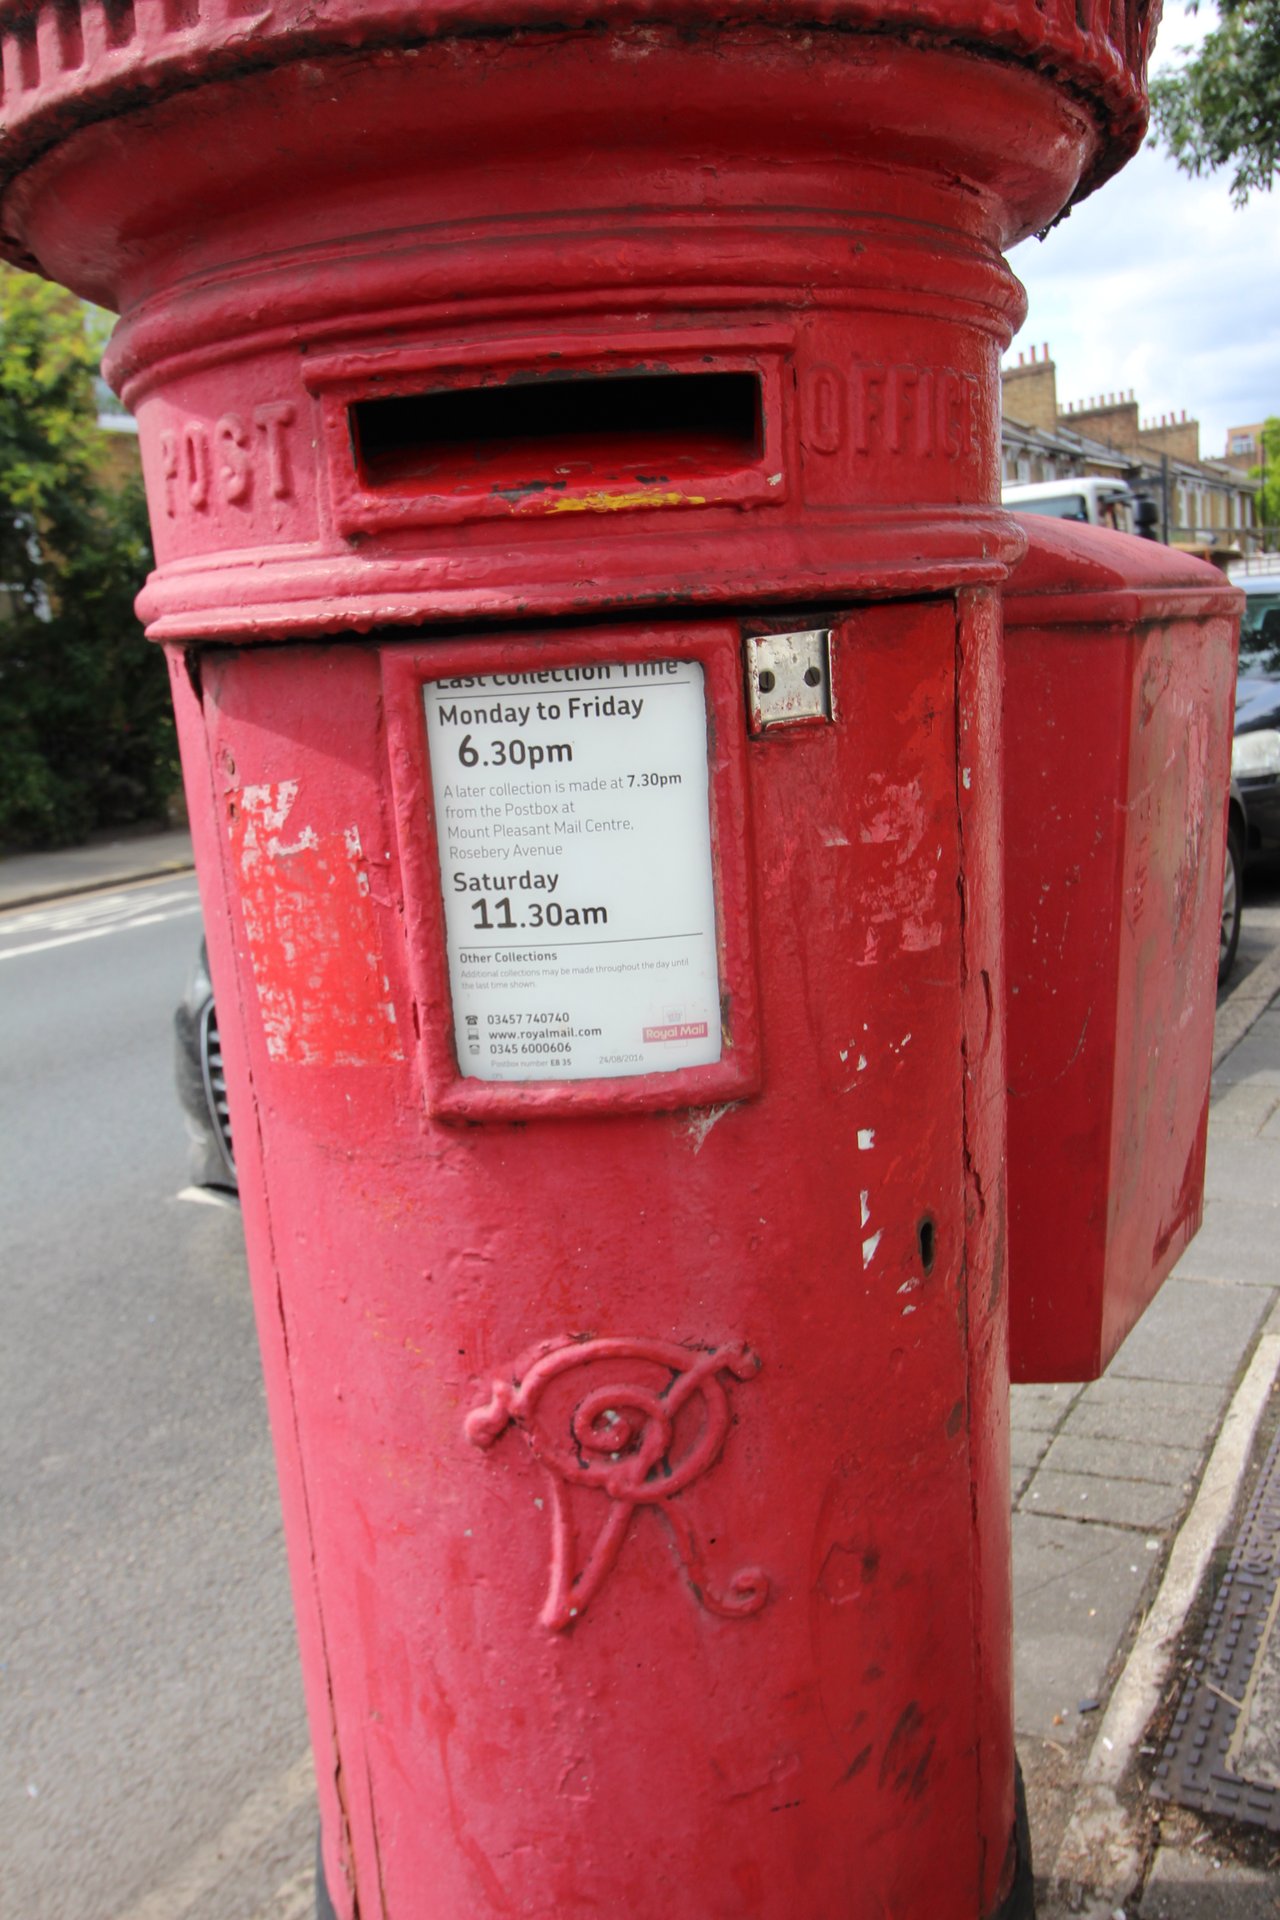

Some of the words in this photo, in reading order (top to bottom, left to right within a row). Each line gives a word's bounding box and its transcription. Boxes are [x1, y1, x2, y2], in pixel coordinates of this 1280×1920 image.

[158, 398, 298, 518] POST
[438, 704, 531, 727] Monday
[536, 701, 561, 721] to
[568, 695, 645, 720] Friday
[457, 734, 574, 770] 6.30pm
[443, 785, 454, 799] A
[455, 783, 486, 799] later
[489, 780, 552, 798] collection
[555, 780, 566, 794] is
[569, 777, 608, 793] made
[610, 776, 624, 790] at
[626, 772, 683, 789] 7.30pm
[445, 805, 478, 820] from
[480, 803, 502, 818] the
[505, 801, 560, 817] Postbox
[561, 801, 576, 814] at
[448, 824, 490, 840] Mount
[493, 822, 551, 838] Pleasant
[554, 820, 583, 835] Mail
[449, 844, 510, 861] Rosebery
[513, 843, 564, 858] Avenue
[453, 869, 560, 893] Saturday
[470, 896, 609, 931] 11.30am
[459, 952, 492, 964] Other
[494, 950, 558, 963] Collections
[460, 969, 499, 979] Additional
[500, 967, 541, 978] collections
[542, 967, 560, 978] may
[560, 966, 571, 976] be
[571, 965, 595, 975] made
[596, 962, 640, 974] throughout
[641, 961, 655, 970] the
[655, 960, 671, 970] day
[671, 957, 690, 968] until
[475, 981, 489, 990] last
[490, 980, 509, 989] time
[487, 1013, 523, 1025] 03457
[525, 1011, 570, 1024] 740740
[488, 1026, 603, 1041] www.royalmail.com
[646, 1026, 679, 1041] Royal
[679, 1023, 705, 1037] Mail
[489, 1043, 518, 1055] 0345
[520, 1041, 573, 1054] 6000606
